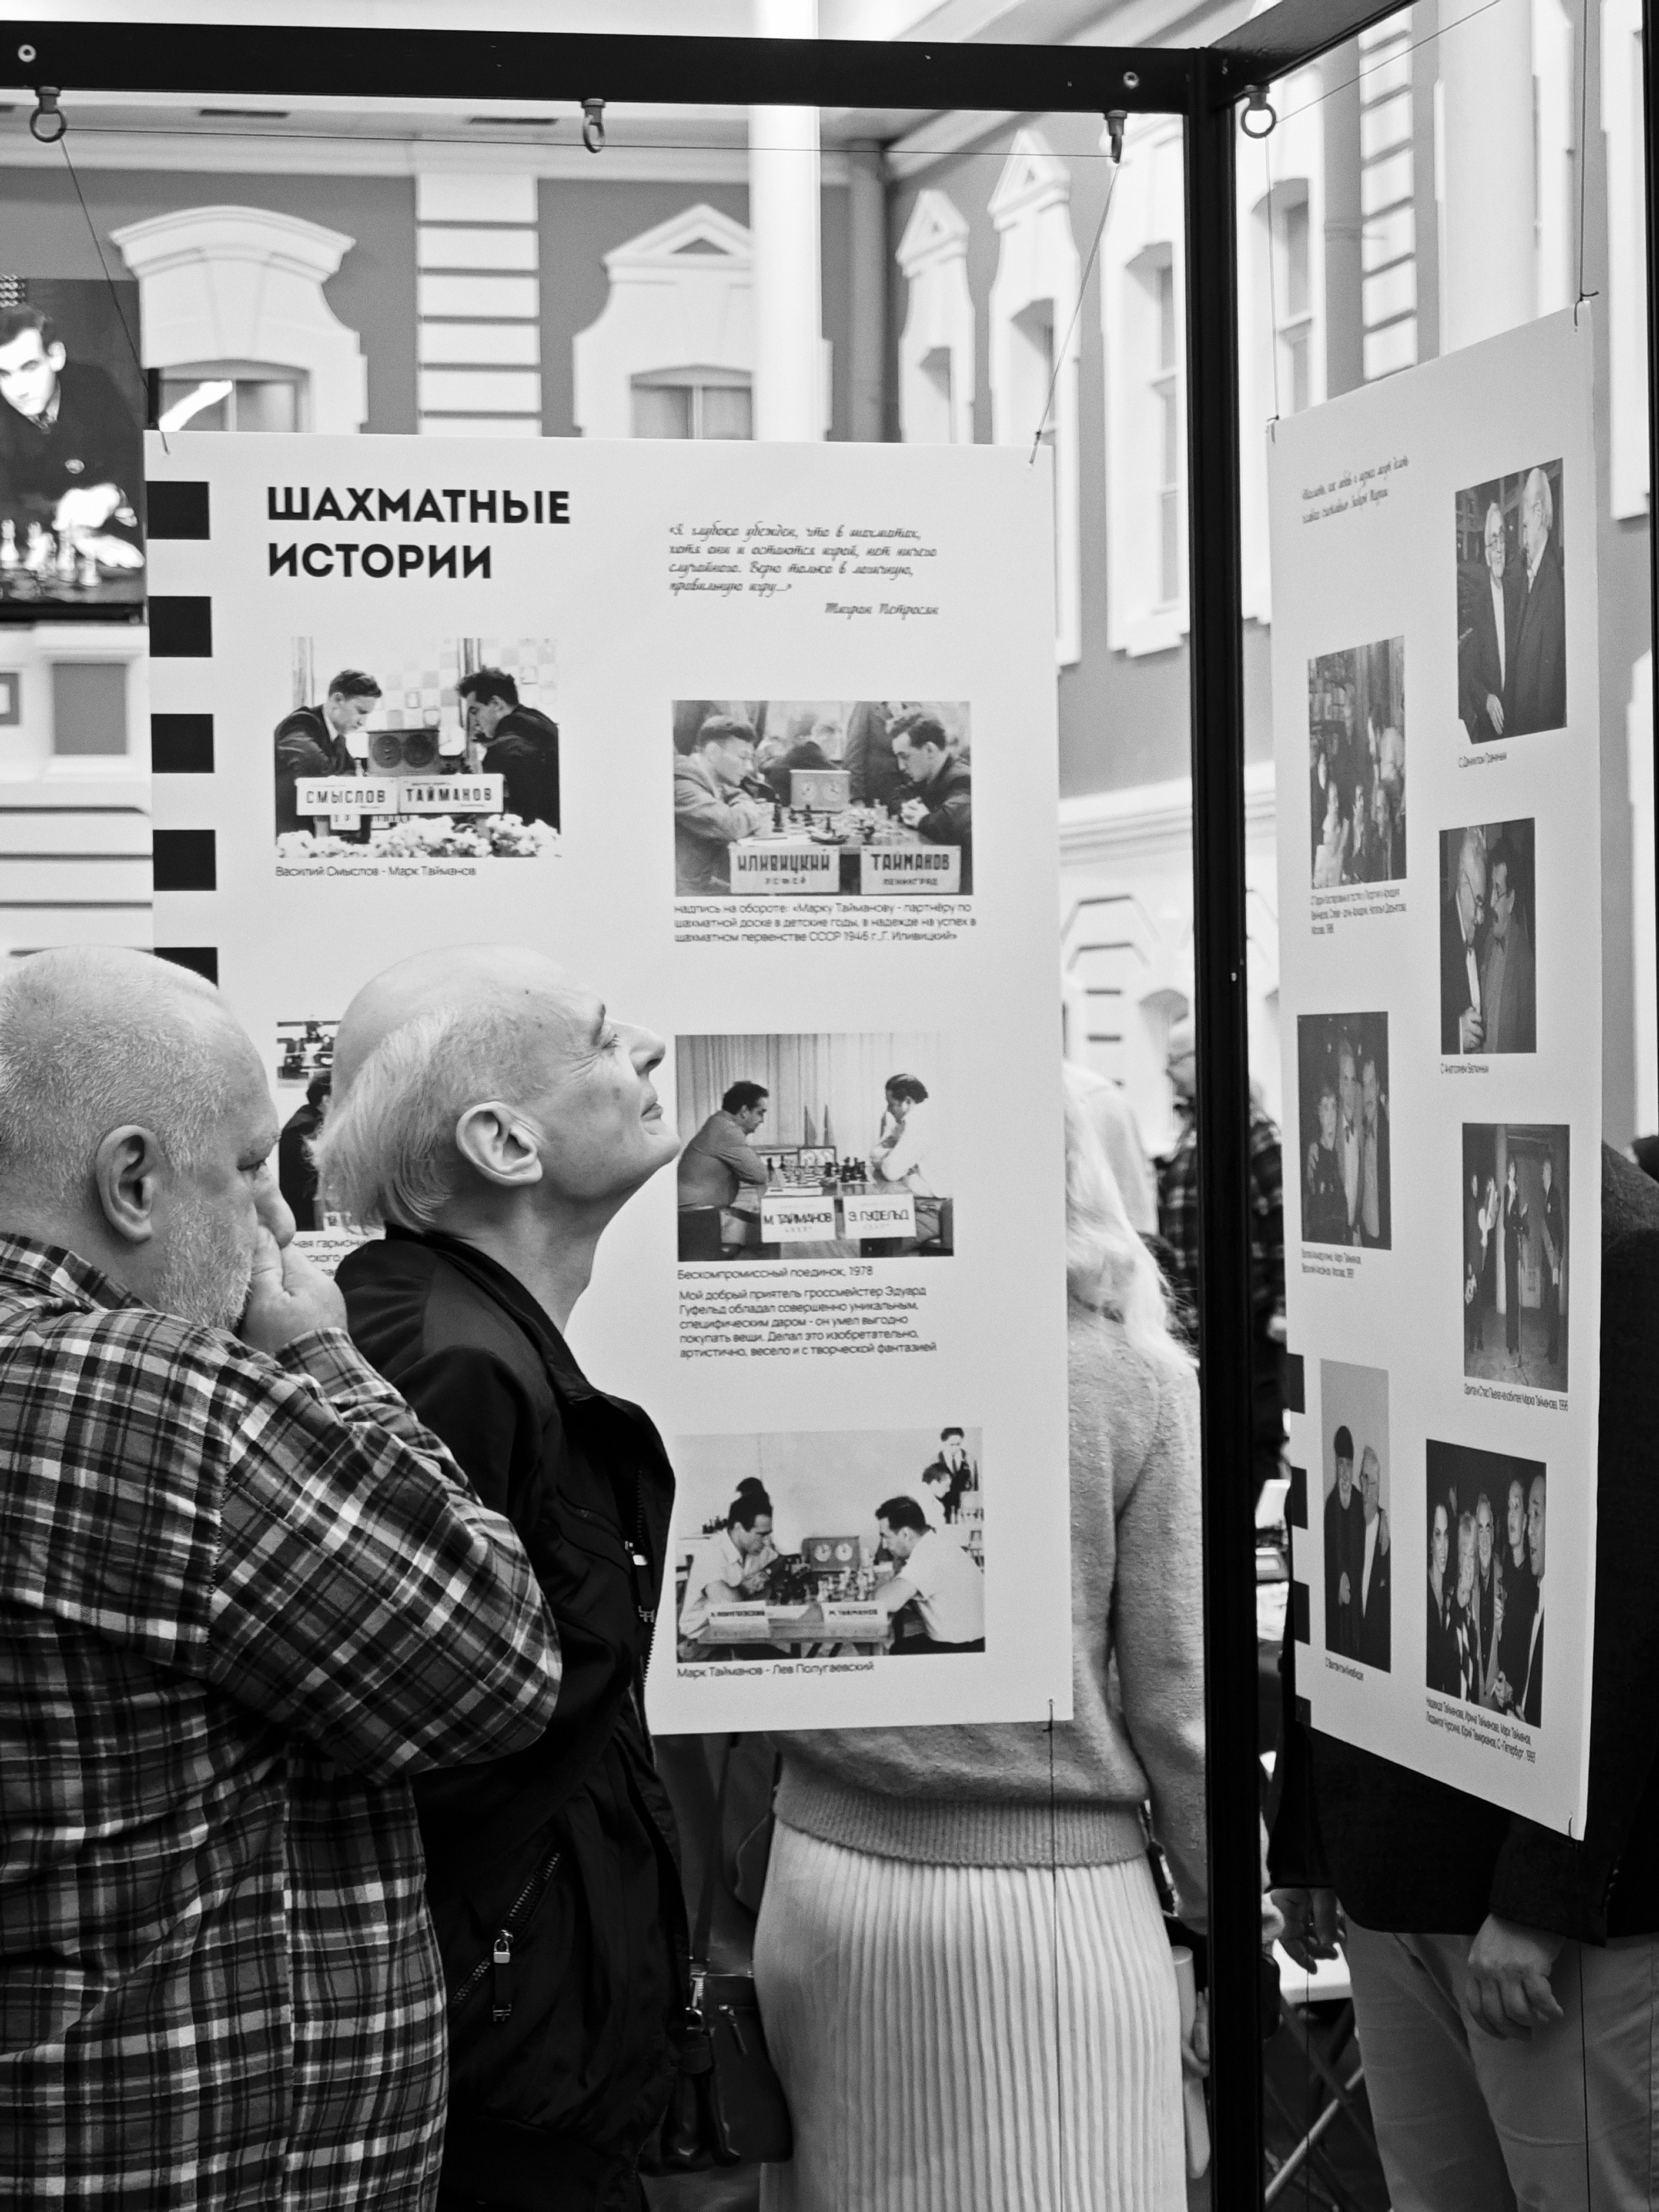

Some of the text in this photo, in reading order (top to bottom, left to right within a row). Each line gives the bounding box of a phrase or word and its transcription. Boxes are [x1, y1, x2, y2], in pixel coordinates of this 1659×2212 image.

[268, 486, 570, 524] ШАХМАТНЫЕ
[691, 520, 739, 542] глубоко
[806, 527, 830, 537] что
[835, 524, 845, 537] в
[849, 528, 921, 541] шахматах,
[669, 544, 701, 554] хотя
[707, 546, 731, 554] они
[751, 545, 815, 555] остаются
[866, 546, 891, 556] нет
[896, 548, 937, 557] ничего
[268, 542, 491, 579] ИСТОРИИ
[749, 561, 782, 579] Верю
[787, 563, 833, 574] только
[838, 561, 848, 574] в
[669, 577, 743, 598] правильную
[824, 602, 940, 620] Тигран Петросян
[306, 790, 386, 804] СМЫСЛОВ
[406, 786, 491, 802] ТАЙМАНОВ
[275, 866, 323, 876] Василий
[327, 866, 379, 876] Смыслов
[388, 867, 419, 879] Марк
[421, 866, 477, 876] Тайманов
[835, 903, 893, 914] Тайманову
[957, 904, 971, 913] по
[674, 918, 737, 927] шахматной
[739, 919, 772, 927] доске
[782, 919, 828, 927] детские
[862, 918, 868, 927] в
[871, 918, 918, 927] надежде
[937, 918, 968, 928] успех
[674, 934, 739, 942] шахматном
[741, 934, 806, 944] первенстве
[809, 931, 841, 941] СССР
[778, 1212, 833, 1224] ТАЙМАНОВ
[860, 1209, 909, 1222] ГУФЕЛЬД
[677, 1268, 788, 1281] Бескомпромиссный
[679, 1285, 927, 1301] Мой добрый приятель гроссмейстер Эдуард
[680, 1305, 726, 1316] Гуфельд
[728, 1303, 776, 1314] обладал
[778, 1304, 847, 1314] совершенно
[680, 1319, 769, 1331] специфическим
[771, 1319, 806, 1329] даром
[815, 1318, 830, 1326] он
[830, 1317, 860, 1328] умел
[861, 1316, 909, 1325] выгодно
[680, 1334, 732, 1345] покупать
[767, 1331, 802, 1342] Делал
[805, 1332, 824, 1340] это
[750, 1347, 791, 1356] весело
[801, 1347, 808, 1355] с
[811, 1344, 874, 1356] творческой
[877, 1342, 937, 1354] фантазией
[677, 1668, 707, 1679] Марк
[710, 1666, 763, 1677] Тайманов
[772, 1664, 795, 1675] Лев
[796, 1662, 875, 1676] Полугаевский
